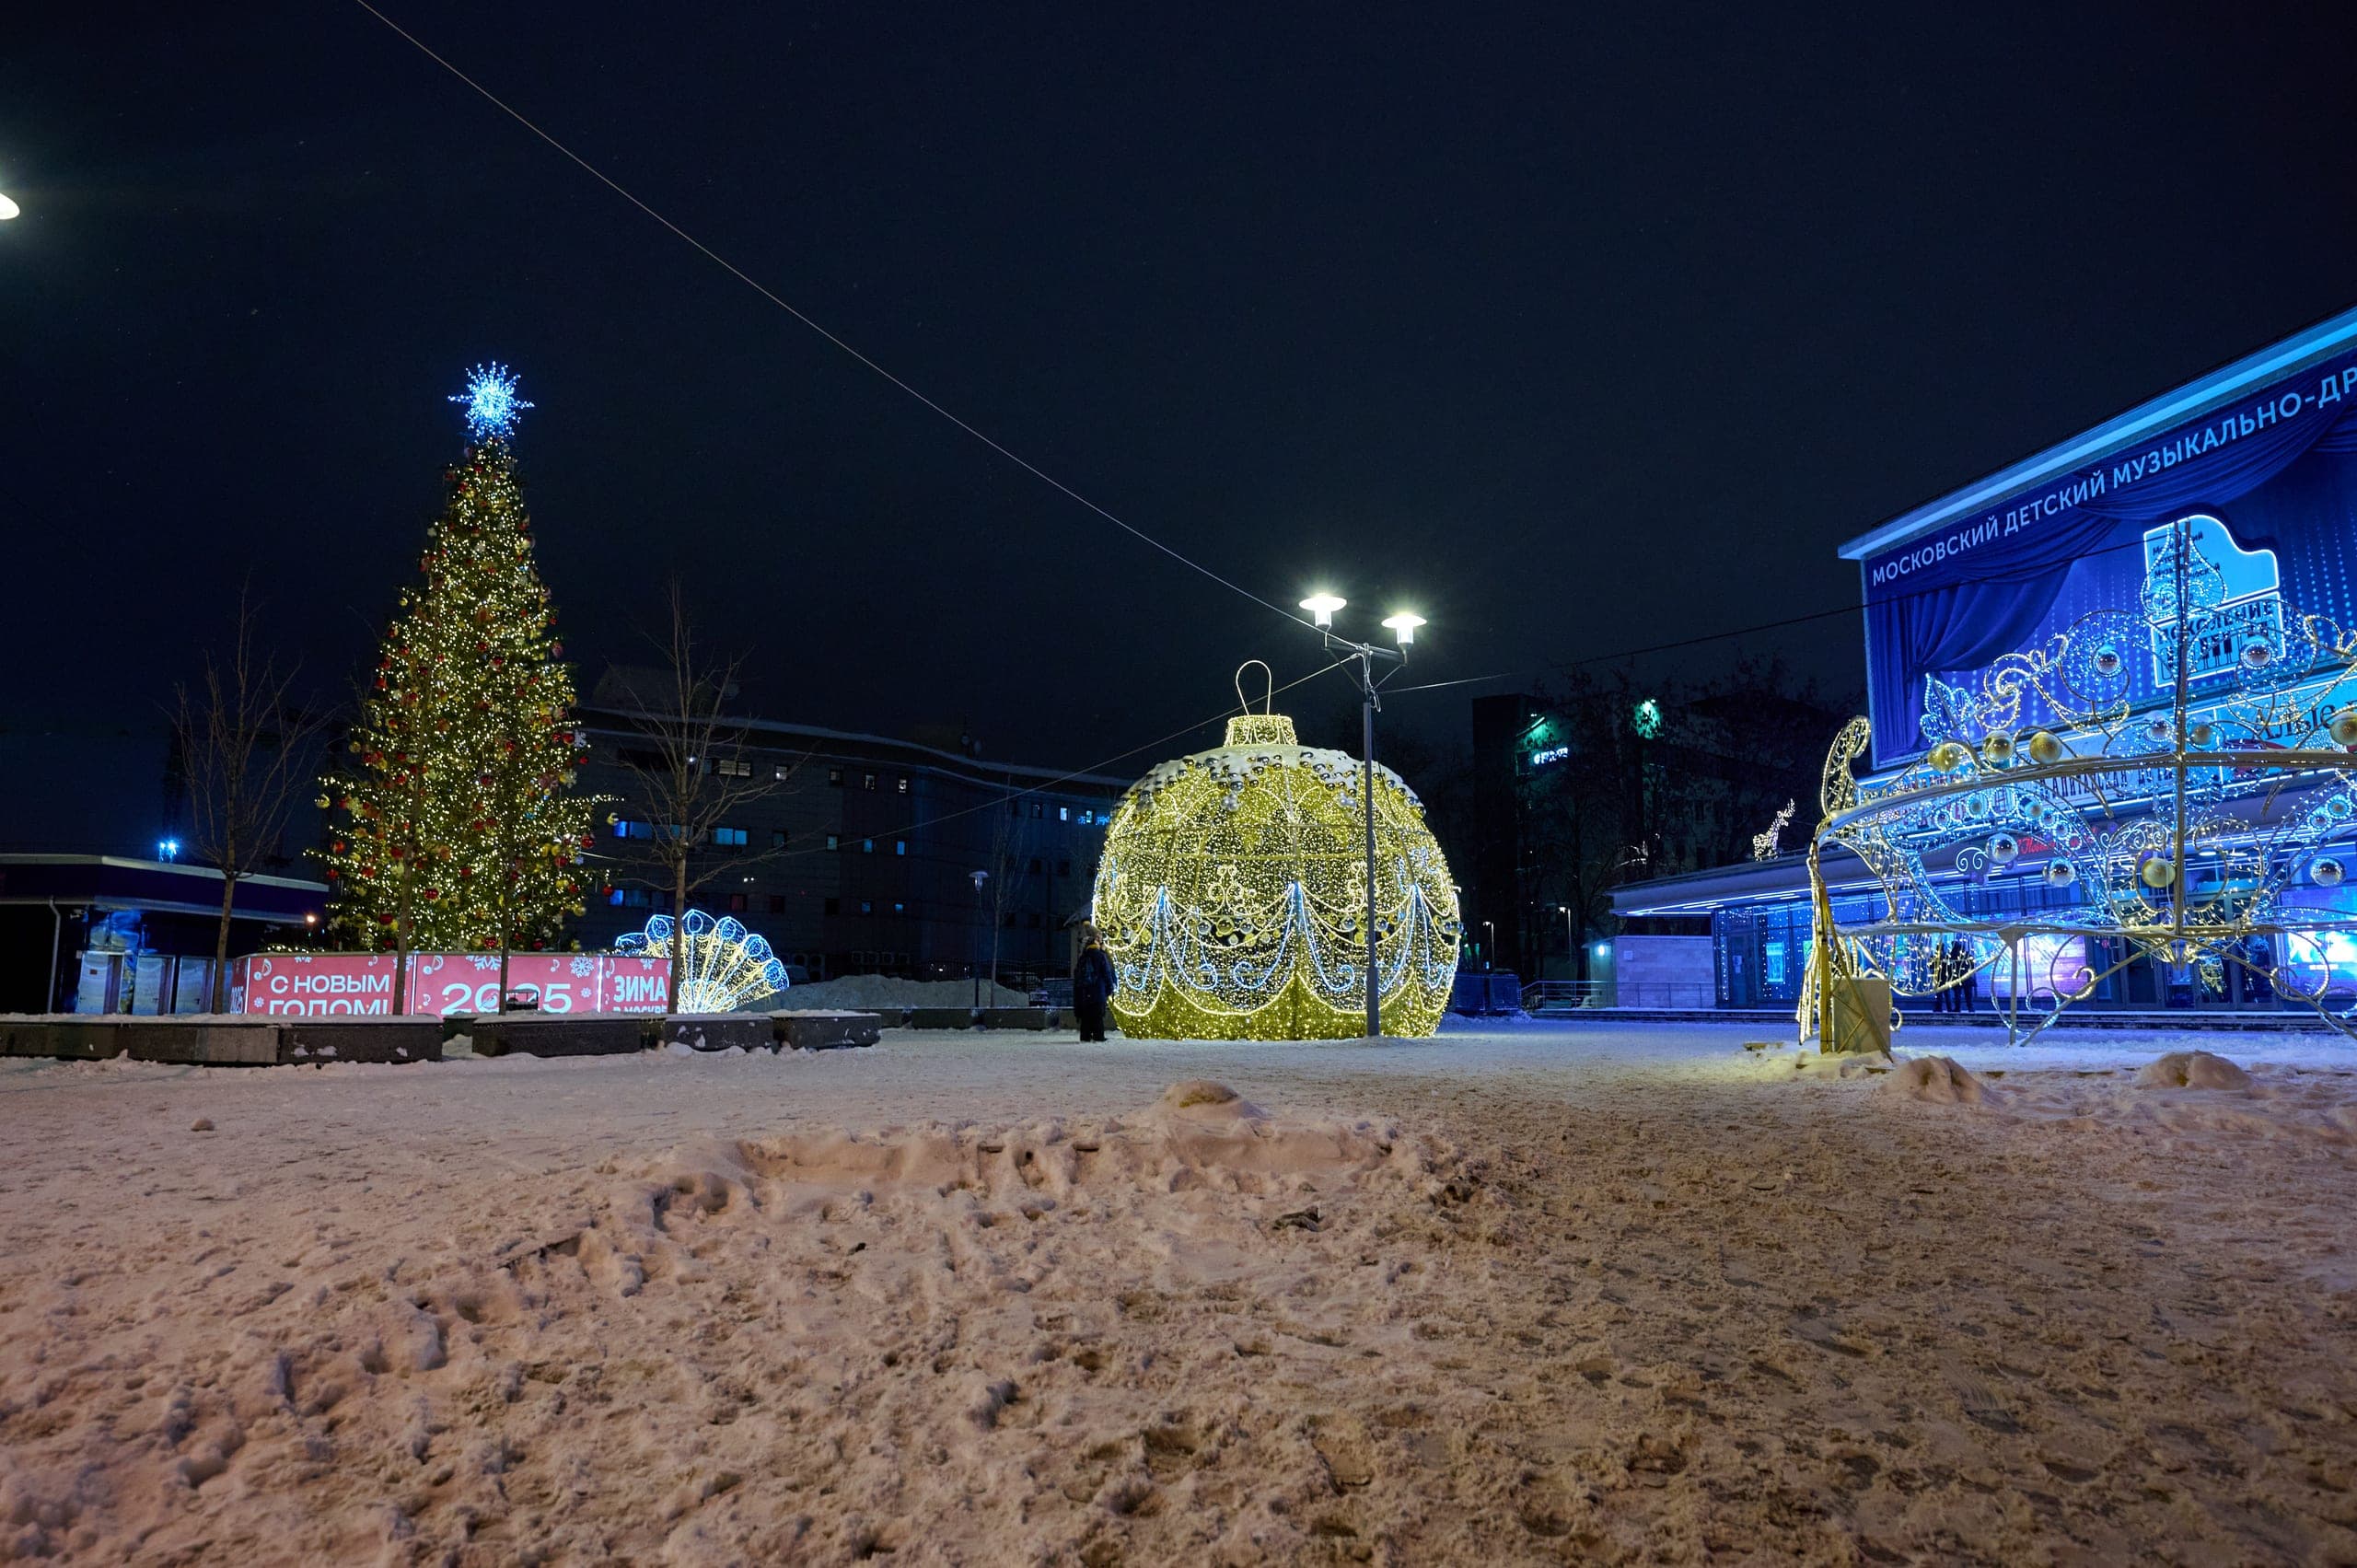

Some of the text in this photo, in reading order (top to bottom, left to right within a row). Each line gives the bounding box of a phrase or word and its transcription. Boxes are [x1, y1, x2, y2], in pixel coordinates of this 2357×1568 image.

[1872, 515, 2000, 587] МОСКОВСКИЙ
[2003, 470, 2106, 537] ДЕТСКИЙ
[270, 973, 390, 994] С НОВЫМ
[613, 975, 668, 1003] ЗИМА
